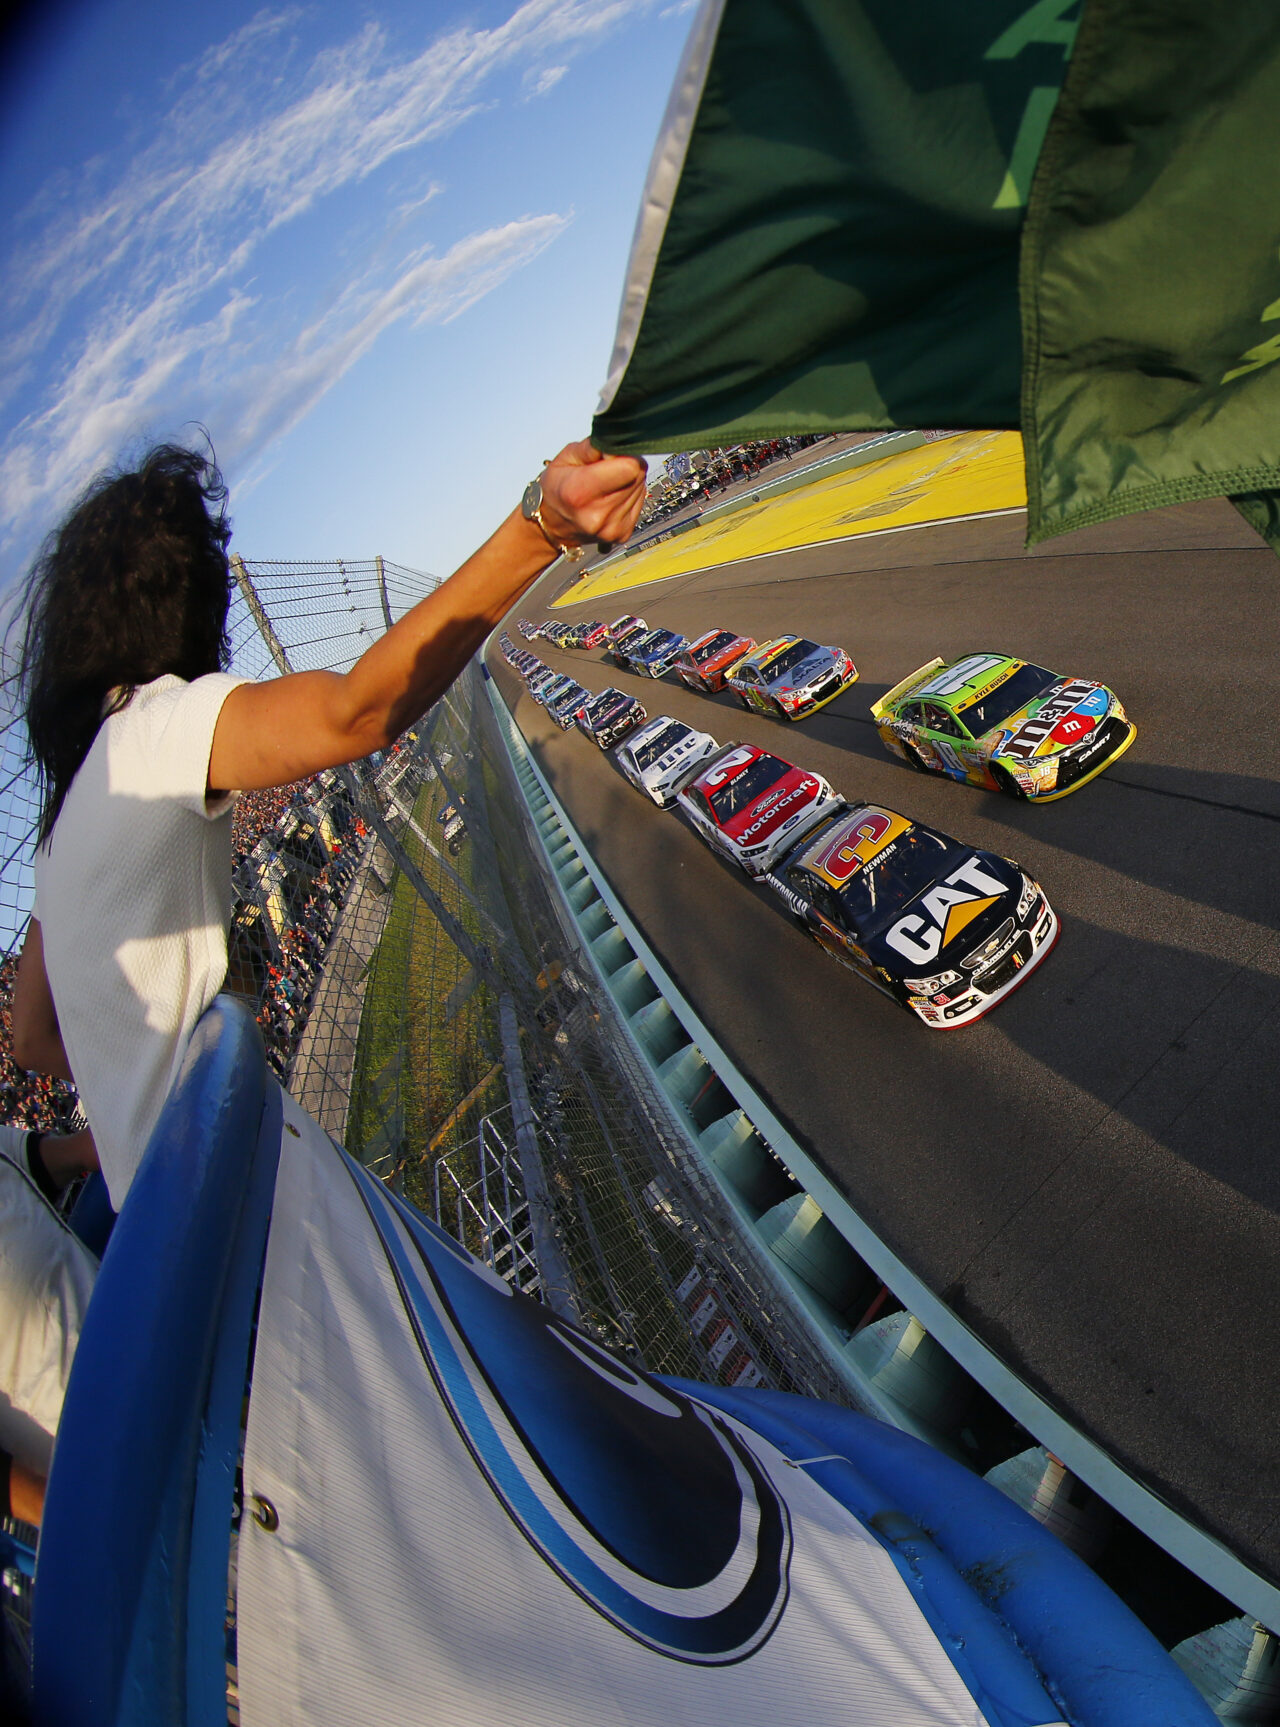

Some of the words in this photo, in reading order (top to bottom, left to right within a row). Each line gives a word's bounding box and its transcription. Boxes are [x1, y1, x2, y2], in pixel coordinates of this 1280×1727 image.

[974, 688, 990, 700] KYLE
[990, 672, 1009, 687] BUSCH
[1062, 720, 1081, 733] m
[1078, 733, 1111, 763] CAMRY
[1039, 766, 1051, 777] 18
[736, 779, 818, 846] Motorcraft
[862, 843, 898, 875] NEWMAN
[885, 857, 1010, 966] CAT
[972, 937, 1014, 976] CHEVROLET
